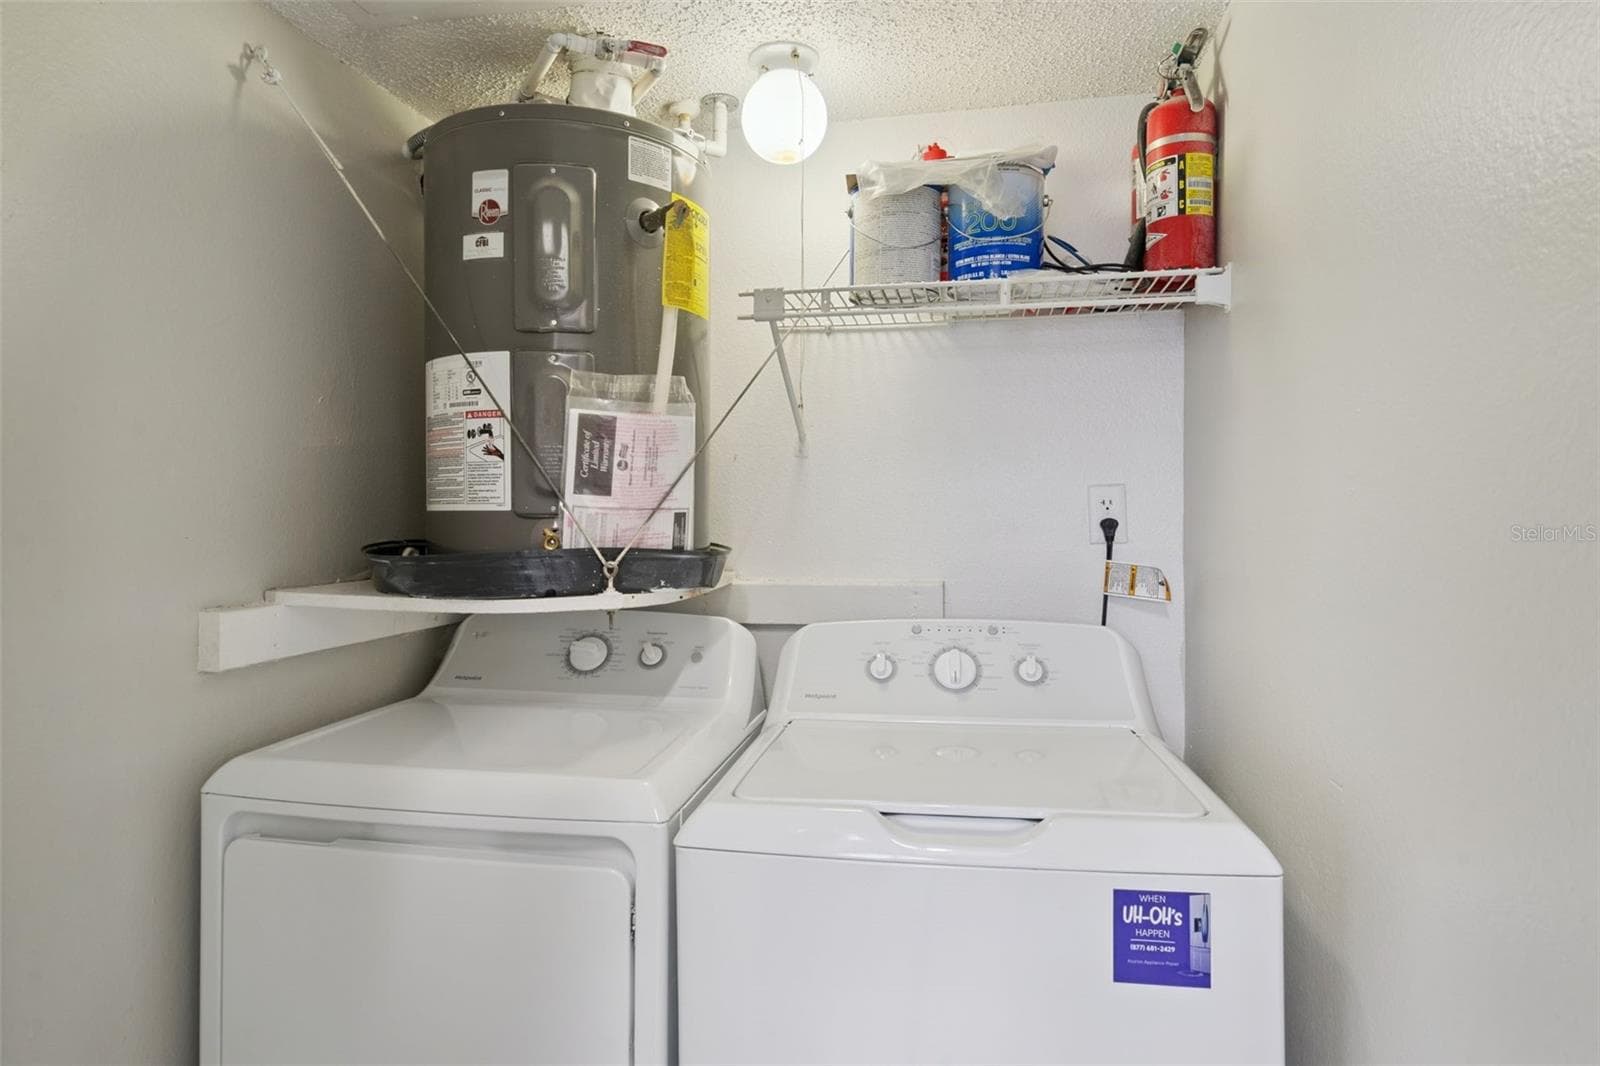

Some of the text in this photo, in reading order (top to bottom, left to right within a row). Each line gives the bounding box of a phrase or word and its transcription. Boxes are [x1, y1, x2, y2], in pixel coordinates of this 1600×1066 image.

[1178, 160, 1185, 170] A
[1178, 179, 1185, 189] B
[1178, 200, 1185, 209] C
[965, 211, 1018, 236] 200
[473, 410, 502, 418] DANGER
[580, 439, 591, 478] Certificate
[1139, 895, 1166, 903] WHEN
[1123, 905, 1182, 926] UH-OH's
[1136, 929, 1170, 938] HAPPEN
[1129, 944, 1145, 952] (877)
